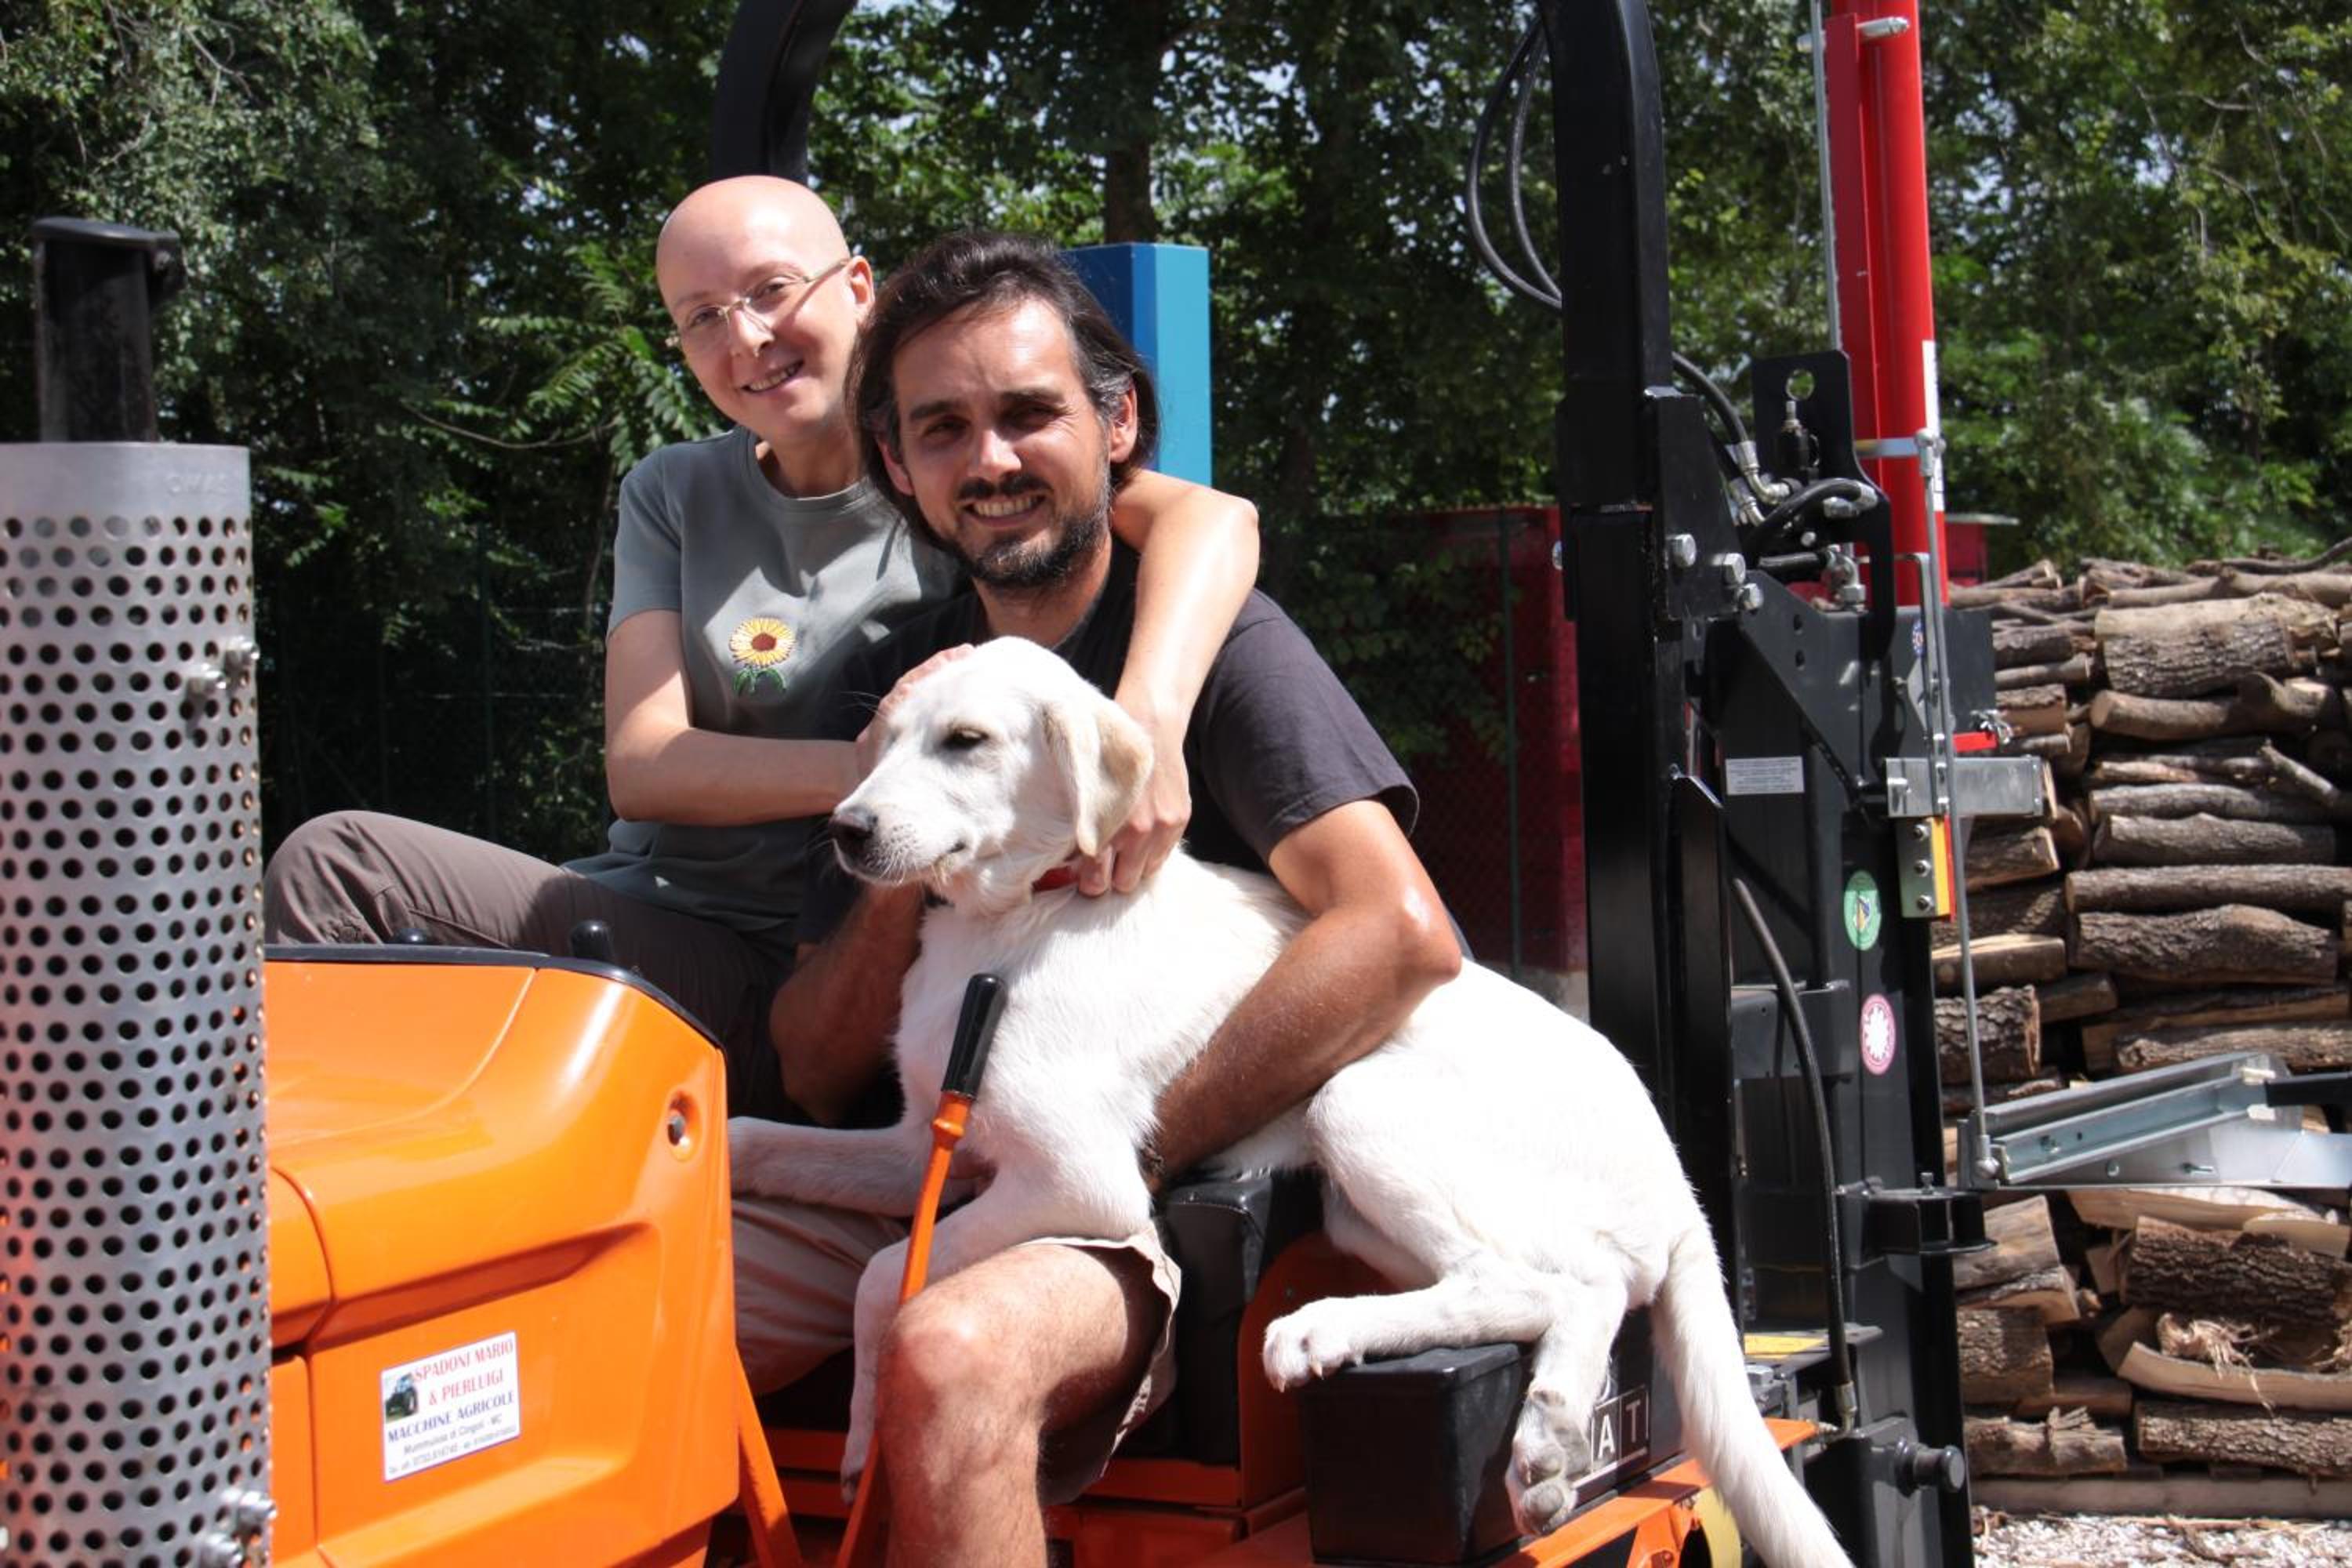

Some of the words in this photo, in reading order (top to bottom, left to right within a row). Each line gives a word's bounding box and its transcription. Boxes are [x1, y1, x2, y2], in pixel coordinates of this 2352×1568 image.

[414, 1351, 470, 1382] SPADONI
[475, 1338, 514, 1363] MARIO
[442, 1368, 504, 1402] PIERLUIGI
[388, 1411, 451, 1443] MACCHINE
[458, 1392, 514, 1420] AGRICOLE
[1598, 1398, 1642, 1460] AT
